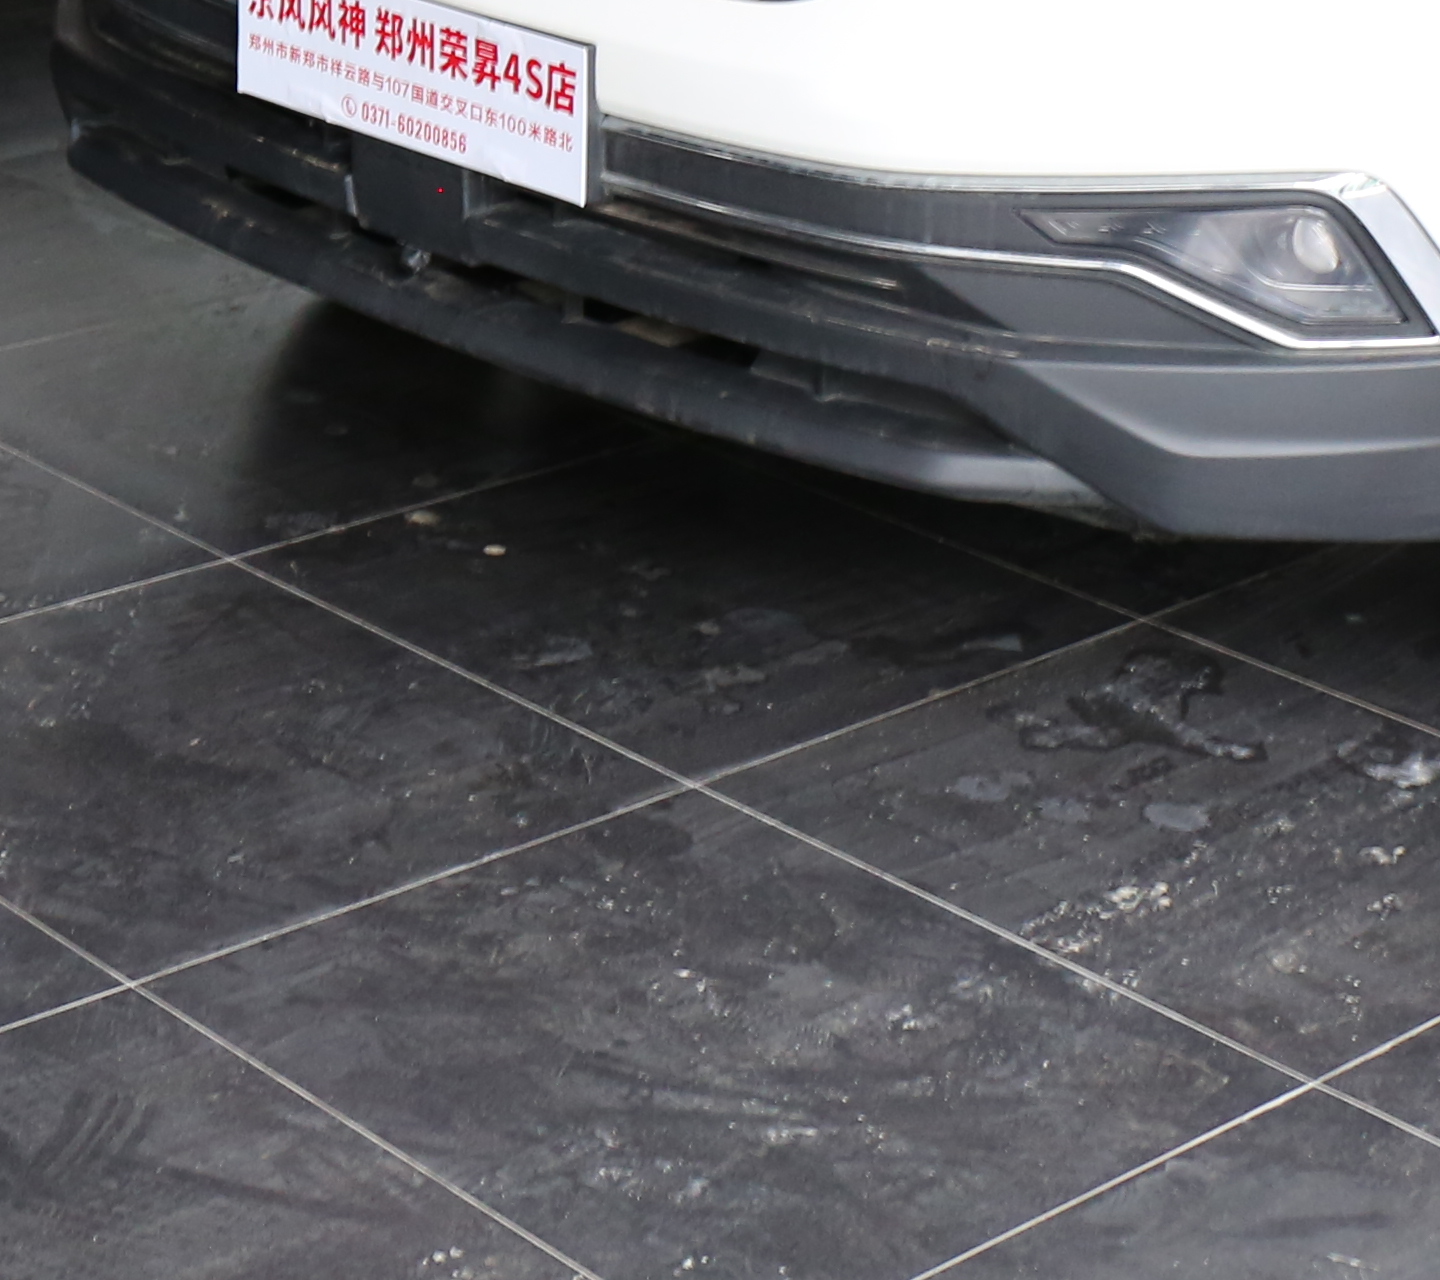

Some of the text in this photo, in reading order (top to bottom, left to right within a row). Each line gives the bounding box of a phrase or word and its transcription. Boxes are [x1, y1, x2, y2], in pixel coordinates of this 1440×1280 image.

[248, 33, 574, 153] 郑州市新郑市祥云路与107国道交叉口东100米路北
[375, 5, 576, 117] 郑州荣昇4S店
[361, 101, 468, 154] 0371-60200856
